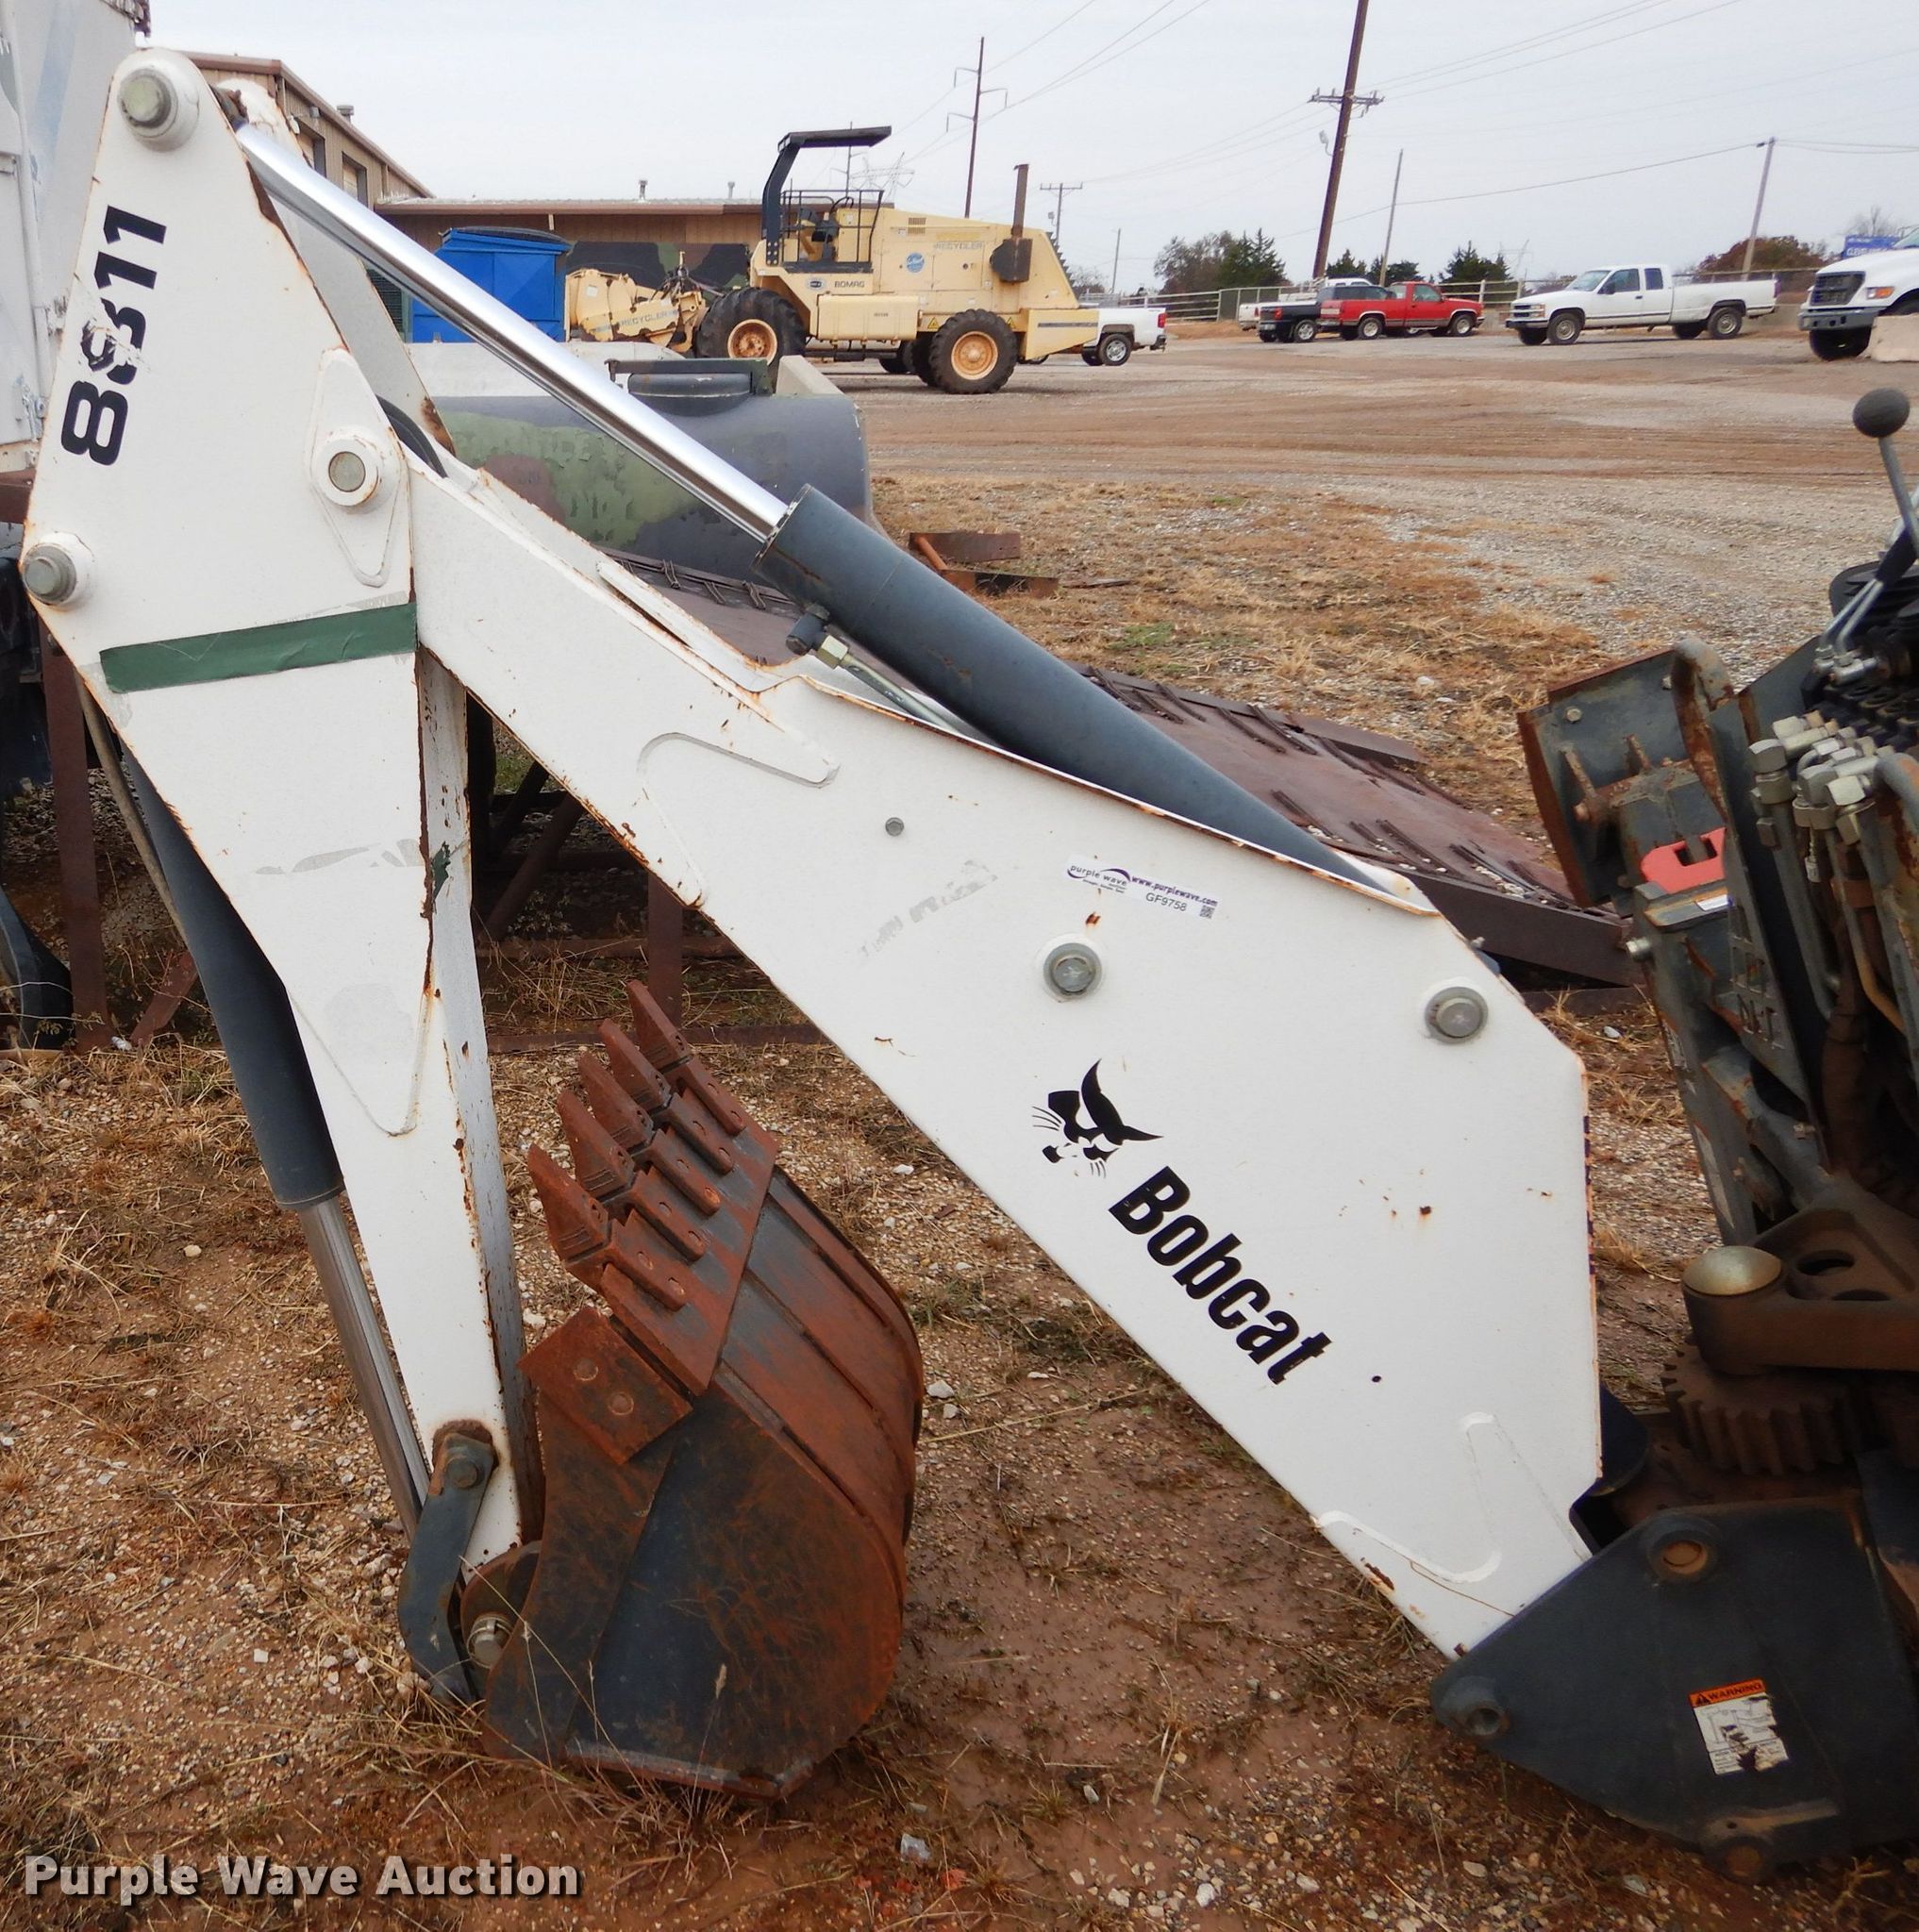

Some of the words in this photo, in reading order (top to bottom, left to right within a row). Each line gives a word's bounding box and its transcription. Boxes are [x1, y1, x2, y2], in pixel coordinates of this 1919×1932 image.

[1070, 865, 1100, 878] purple
[1103, 875, 1127, 886] wave
[1132, 876, 1218, 907] www.purplewave.com
[1145, 892, 1187, 911] GF9758
[1108, 1166, 1332, 1386] Bobcat
[1708, 1683, 1762, 1700] WARNING
